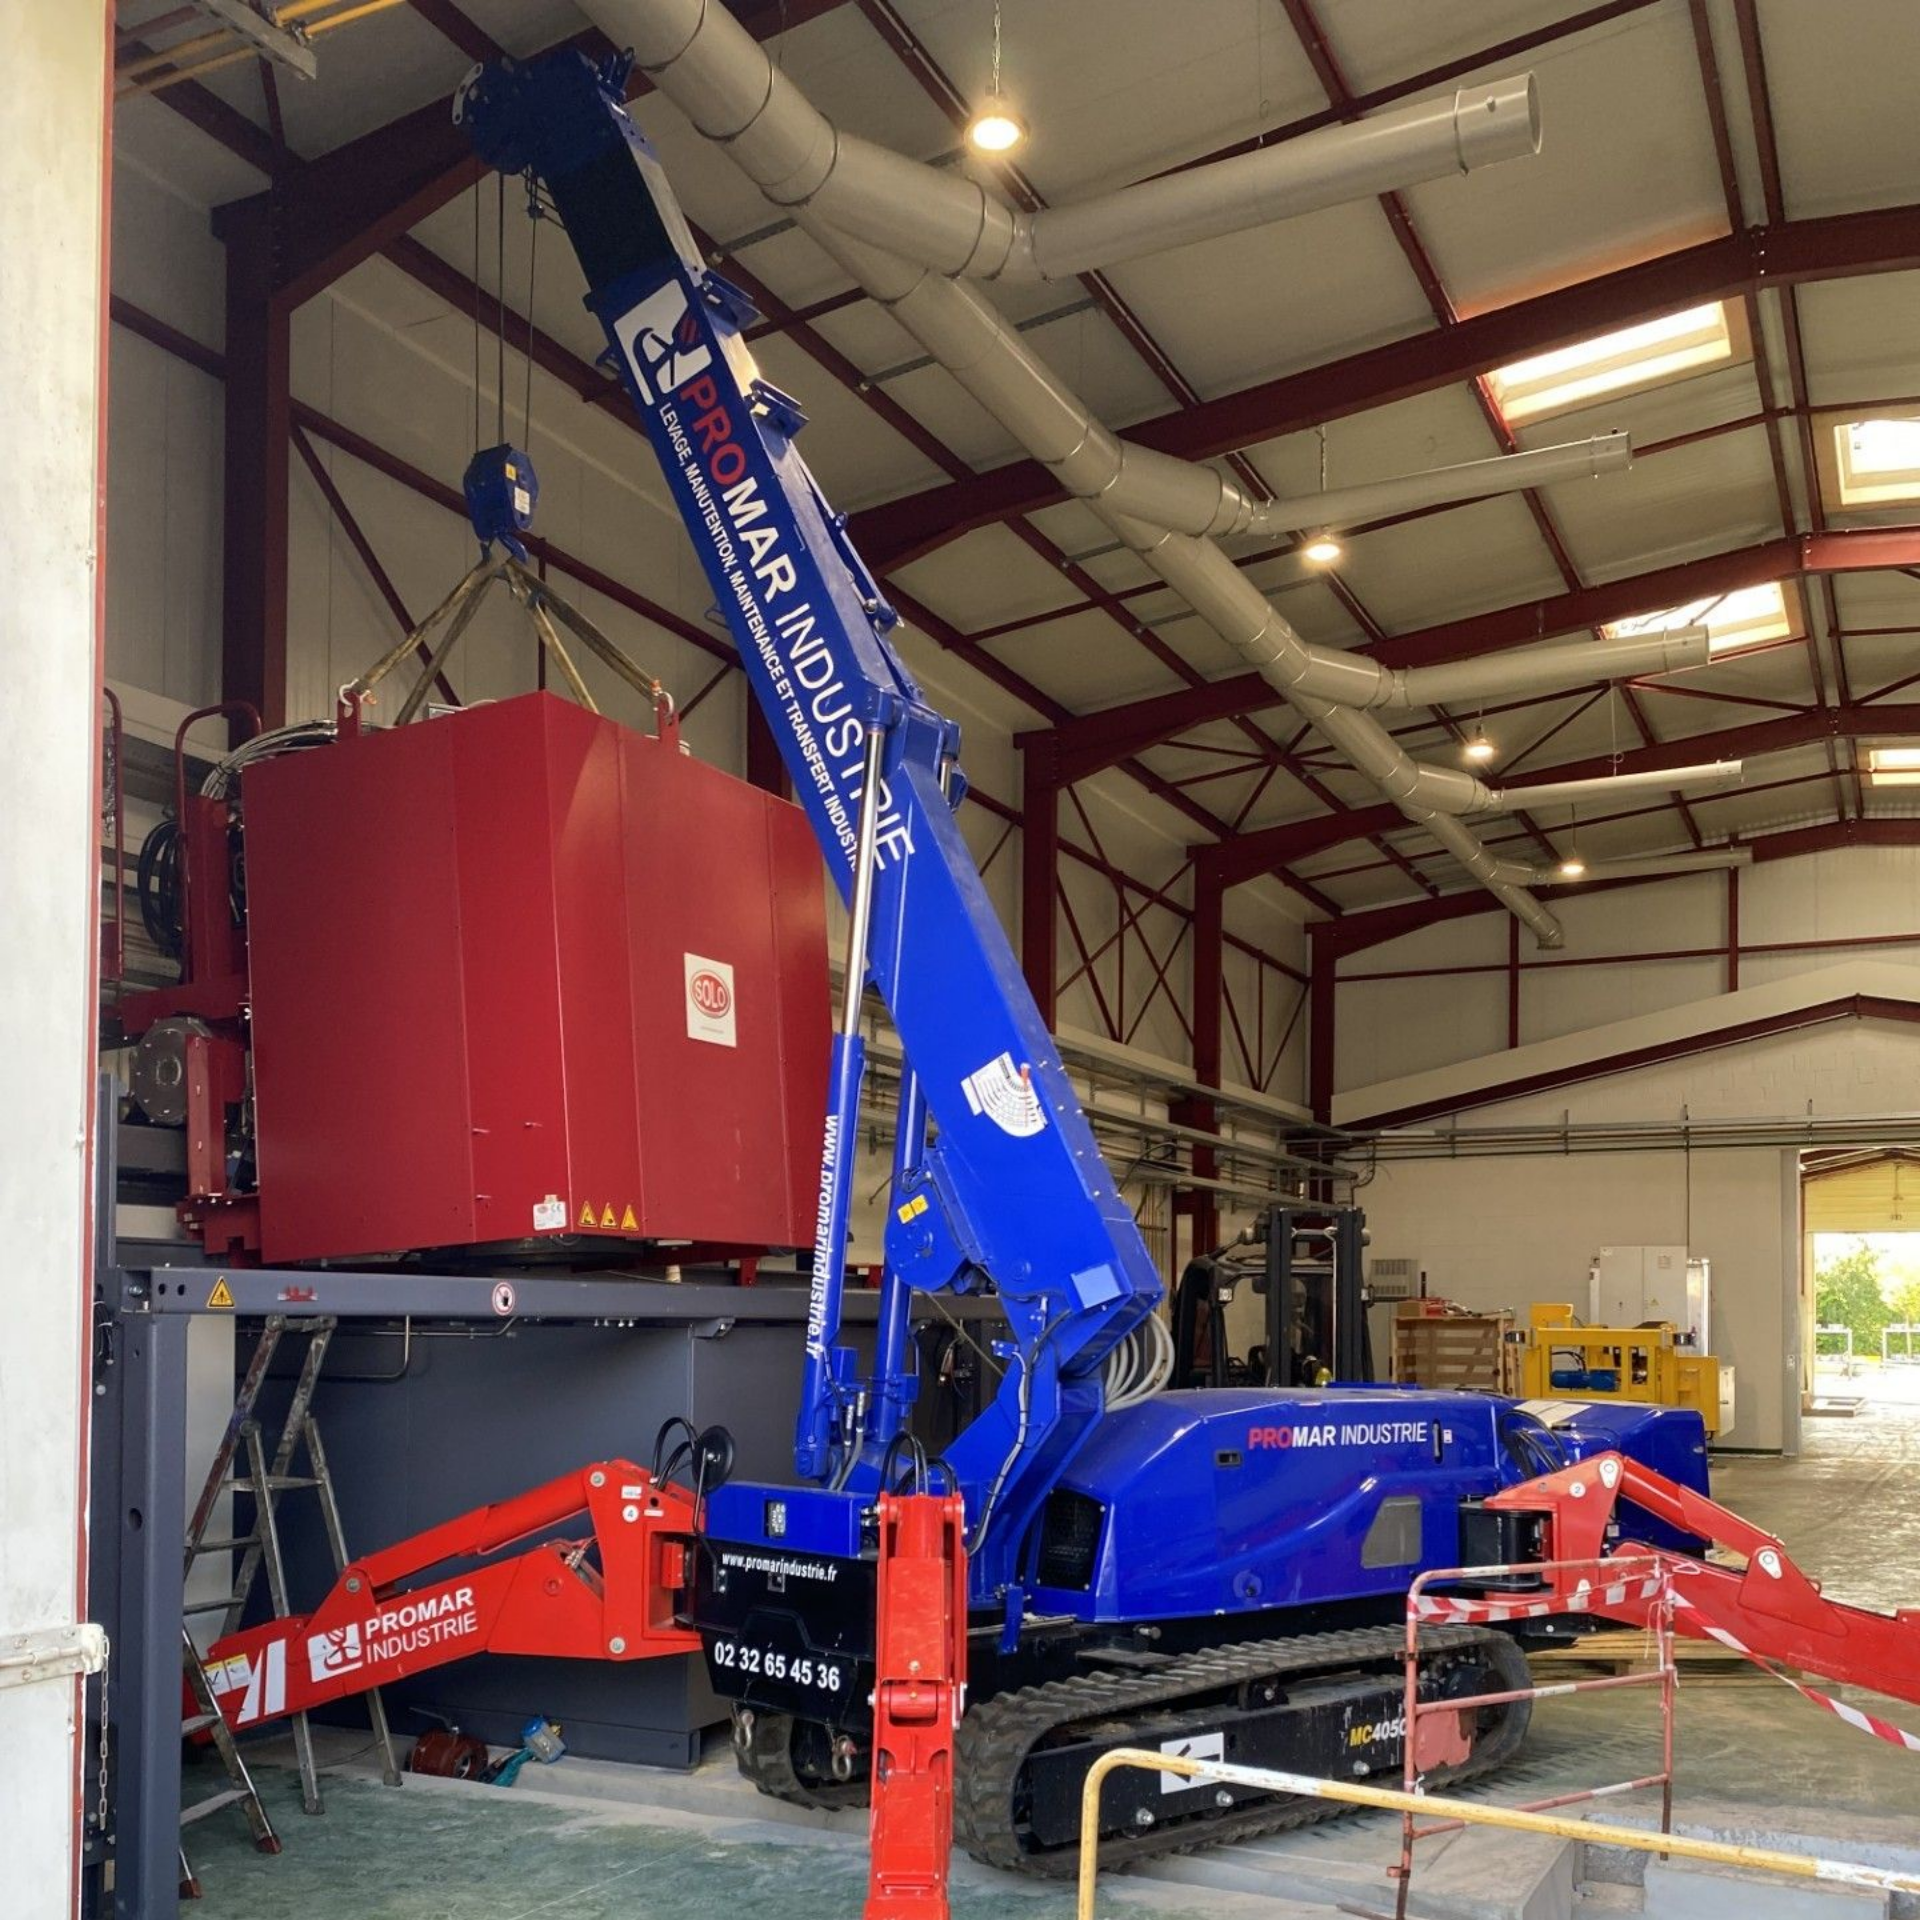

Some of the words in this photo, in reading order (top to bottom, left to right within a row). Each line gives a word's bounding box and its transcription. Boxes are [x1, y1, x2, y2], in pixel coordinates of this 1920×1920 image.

[659, 402, 692, 466] LEVAGE,
[680, 375, 797, 603] PROMAR
[684, 462, 738, 574] MANUTENTION,
[729, 571, 784, 682] MAINTENANCE
[775, 675, 795, 704] ET
[784, 699, 834, 797] TRANSFERT
[694, 979, 726, 1009] SOLO
[806, 1114, 838, 1360] www.promarindustrie.fr
[1249, 1424, 1336, 1449] PROMAR
[1340, 1421, 1428, 1446] INDUSTRIE
[722, 1552, 838, 1582] www.promarindustrie.fr
[365, 1586, 475, 1640] PROMAR
[366, 1610, 479, 1665] INDUSTRIE
[714, 1641, 734, 1667] 02
[739, 1647, 760, 1673] 32
[764, 1652, 786, 1679] 65
[790, 1658, 813, 1685] 45
[816, 1664, 840, 1691] 36
